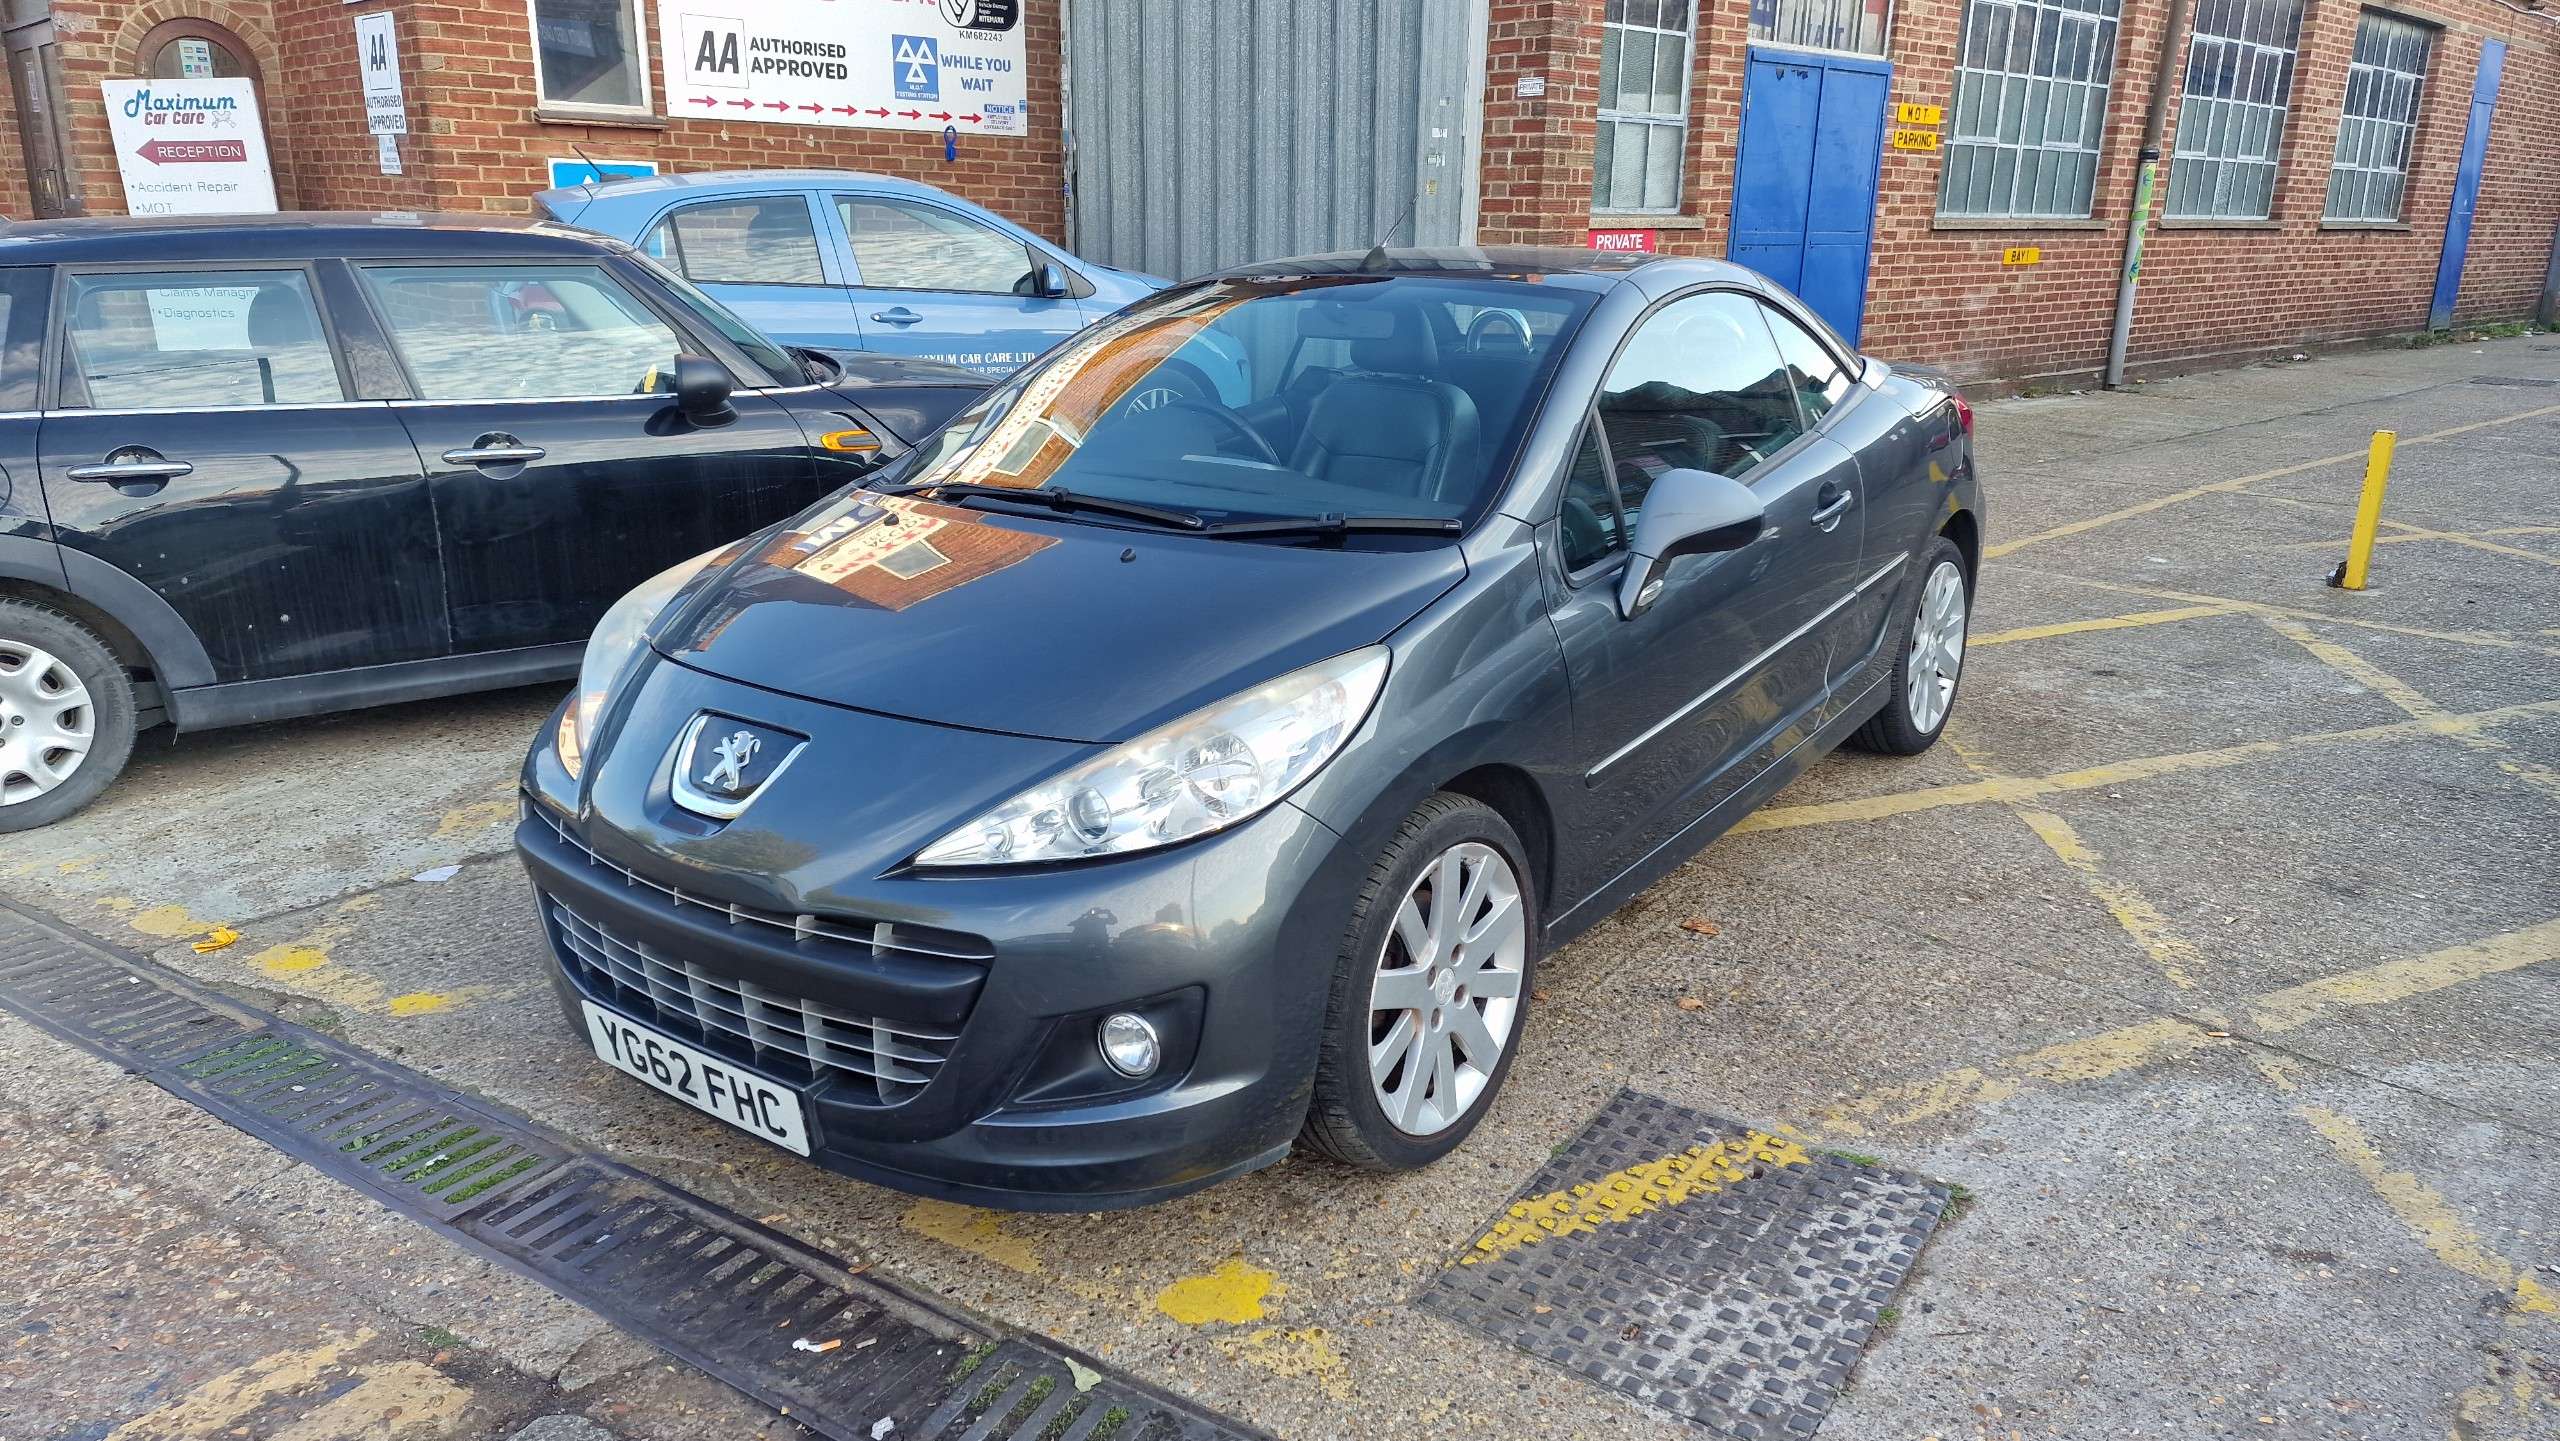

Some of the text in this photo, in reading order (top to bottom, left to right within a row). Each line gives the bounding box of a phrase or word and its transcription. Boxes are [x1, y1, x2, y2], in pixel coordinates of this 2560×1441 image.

[959, 30, 1003, 42] KM682243
[370, 33, 387, 71] AA
[694, 30, 740, 74] AA
[750, 36, 846, 58] AUTHORISED
[751, 56, 848, 80] APPROVED
[940, 54, 1011, 73] WHILE YOU
[960, 76, 994, 92] WAIT
[124, 89, 237, 118] Maximum
[366, 95, 402, 108] AUTHORISED
[986, 104, 1014, 114] NOTICE
[369, 114, 405, 130] APPROVED
[1897, 131, 1933, 148] PARKING
[157, 145, 241, 158] RECEPTION
[138, 181, 239, 196] Accident Repair
[142, 202, 173, 214] MOT
[1596, 233, 1644, 250] PRIVATE
[163, 307, 235, 321] Diagnostics
[960, 352, 982, 365] CAR
[985, 351, 1013, 364] CARE
[986, 365, 1020, 375] SPECIAL
[597, 1014, 788, 1139] YG62 FHC
